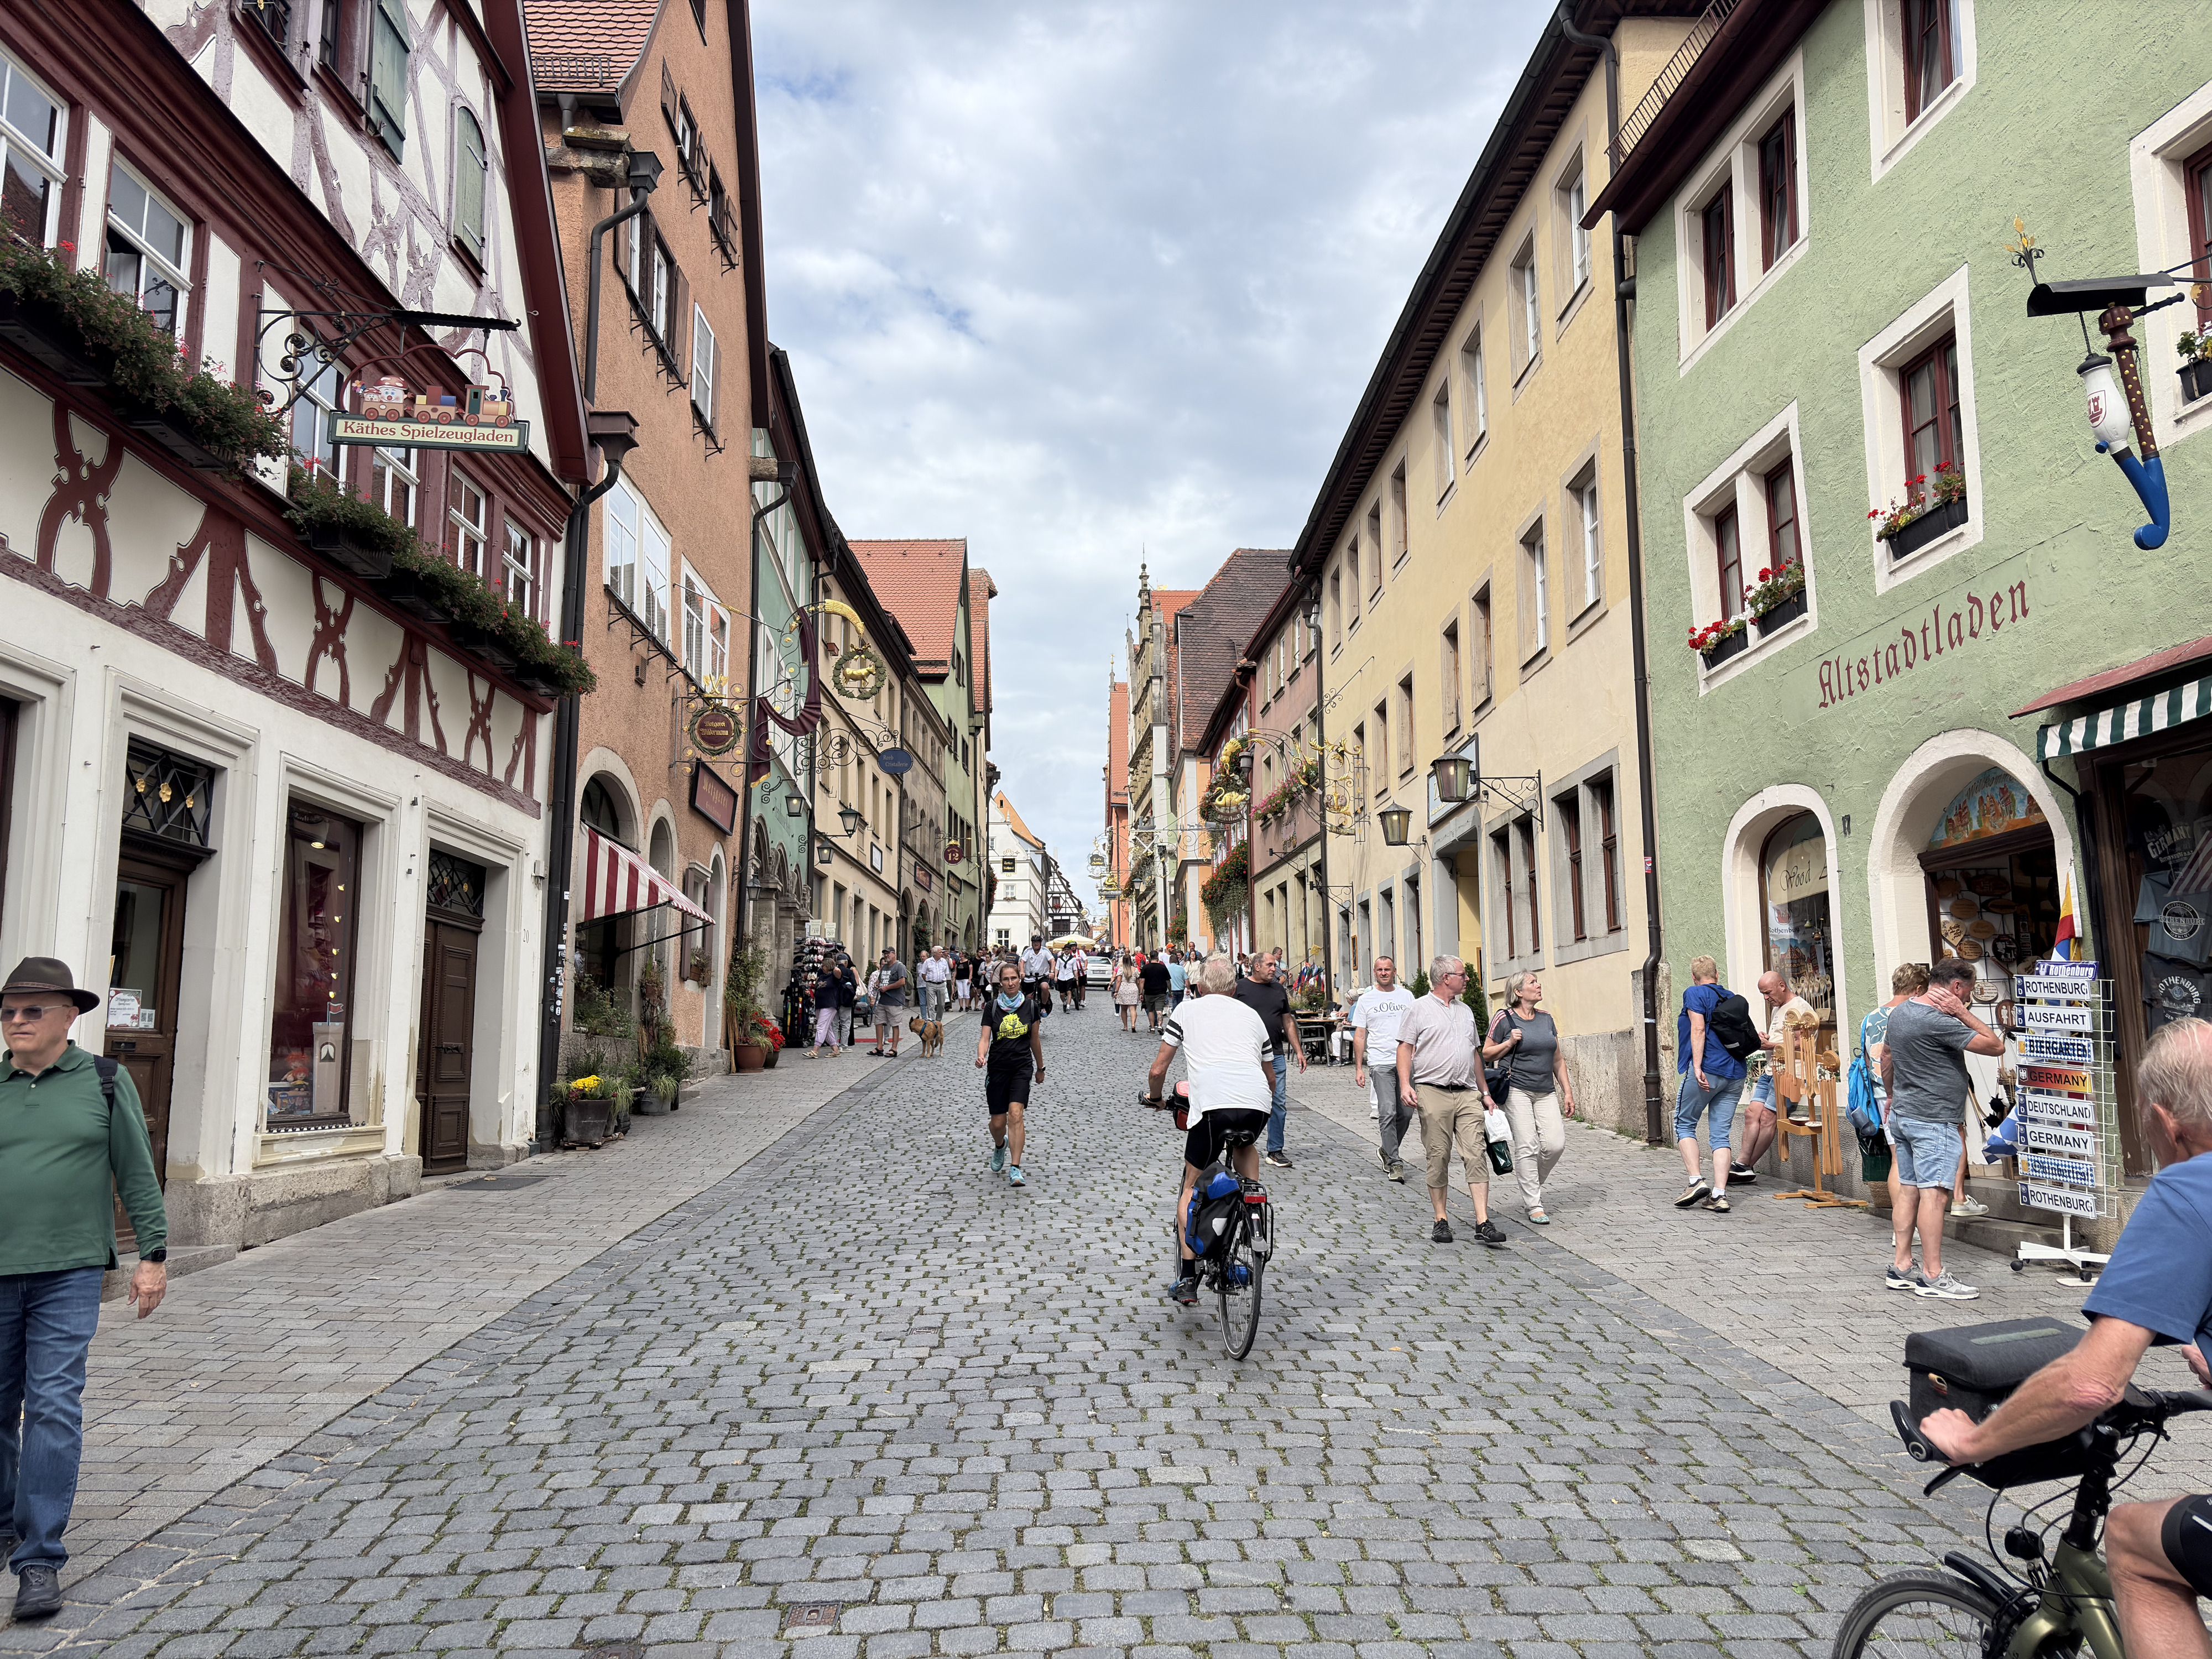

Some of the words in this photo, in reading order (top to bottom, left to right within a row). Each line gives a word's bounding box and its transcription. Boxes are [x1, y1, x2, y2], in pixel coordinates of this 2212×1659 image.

[343, 421, 396, 436] Käthes
[400, 425, 513, 442] Spielzeugladen
[1819, 580, 2029, 708] Altstadtladen
[703, 774, 728, 808] Metzgerei
[1966, 773, 2017, 800] Willkomme
[2147, 826, 2191, 859] GERMANY
[948, 853, 959, 861] 12
[1780, 859, 1811, 891] Wood
[2049, 964, 2094, 978] Rothenburg
[2025, 982, 2088, 995] ROTHENBURG
[2028, 1012, 2086, 1025] AUSFAHRT
[2029, 1040, 2088, 1057] BIERGARTEN
[2030, 1071, 2087, 1087] GERMANY
[2028, 1100, 2090, 1119] DEUTSCHLAND
[2029, 1130, 2088, 1150] GERMANY
[2032, 1160, 2089, 1181] Oktoberfest
[2030, 1190, 2093, 1212] ROTHENBURG
